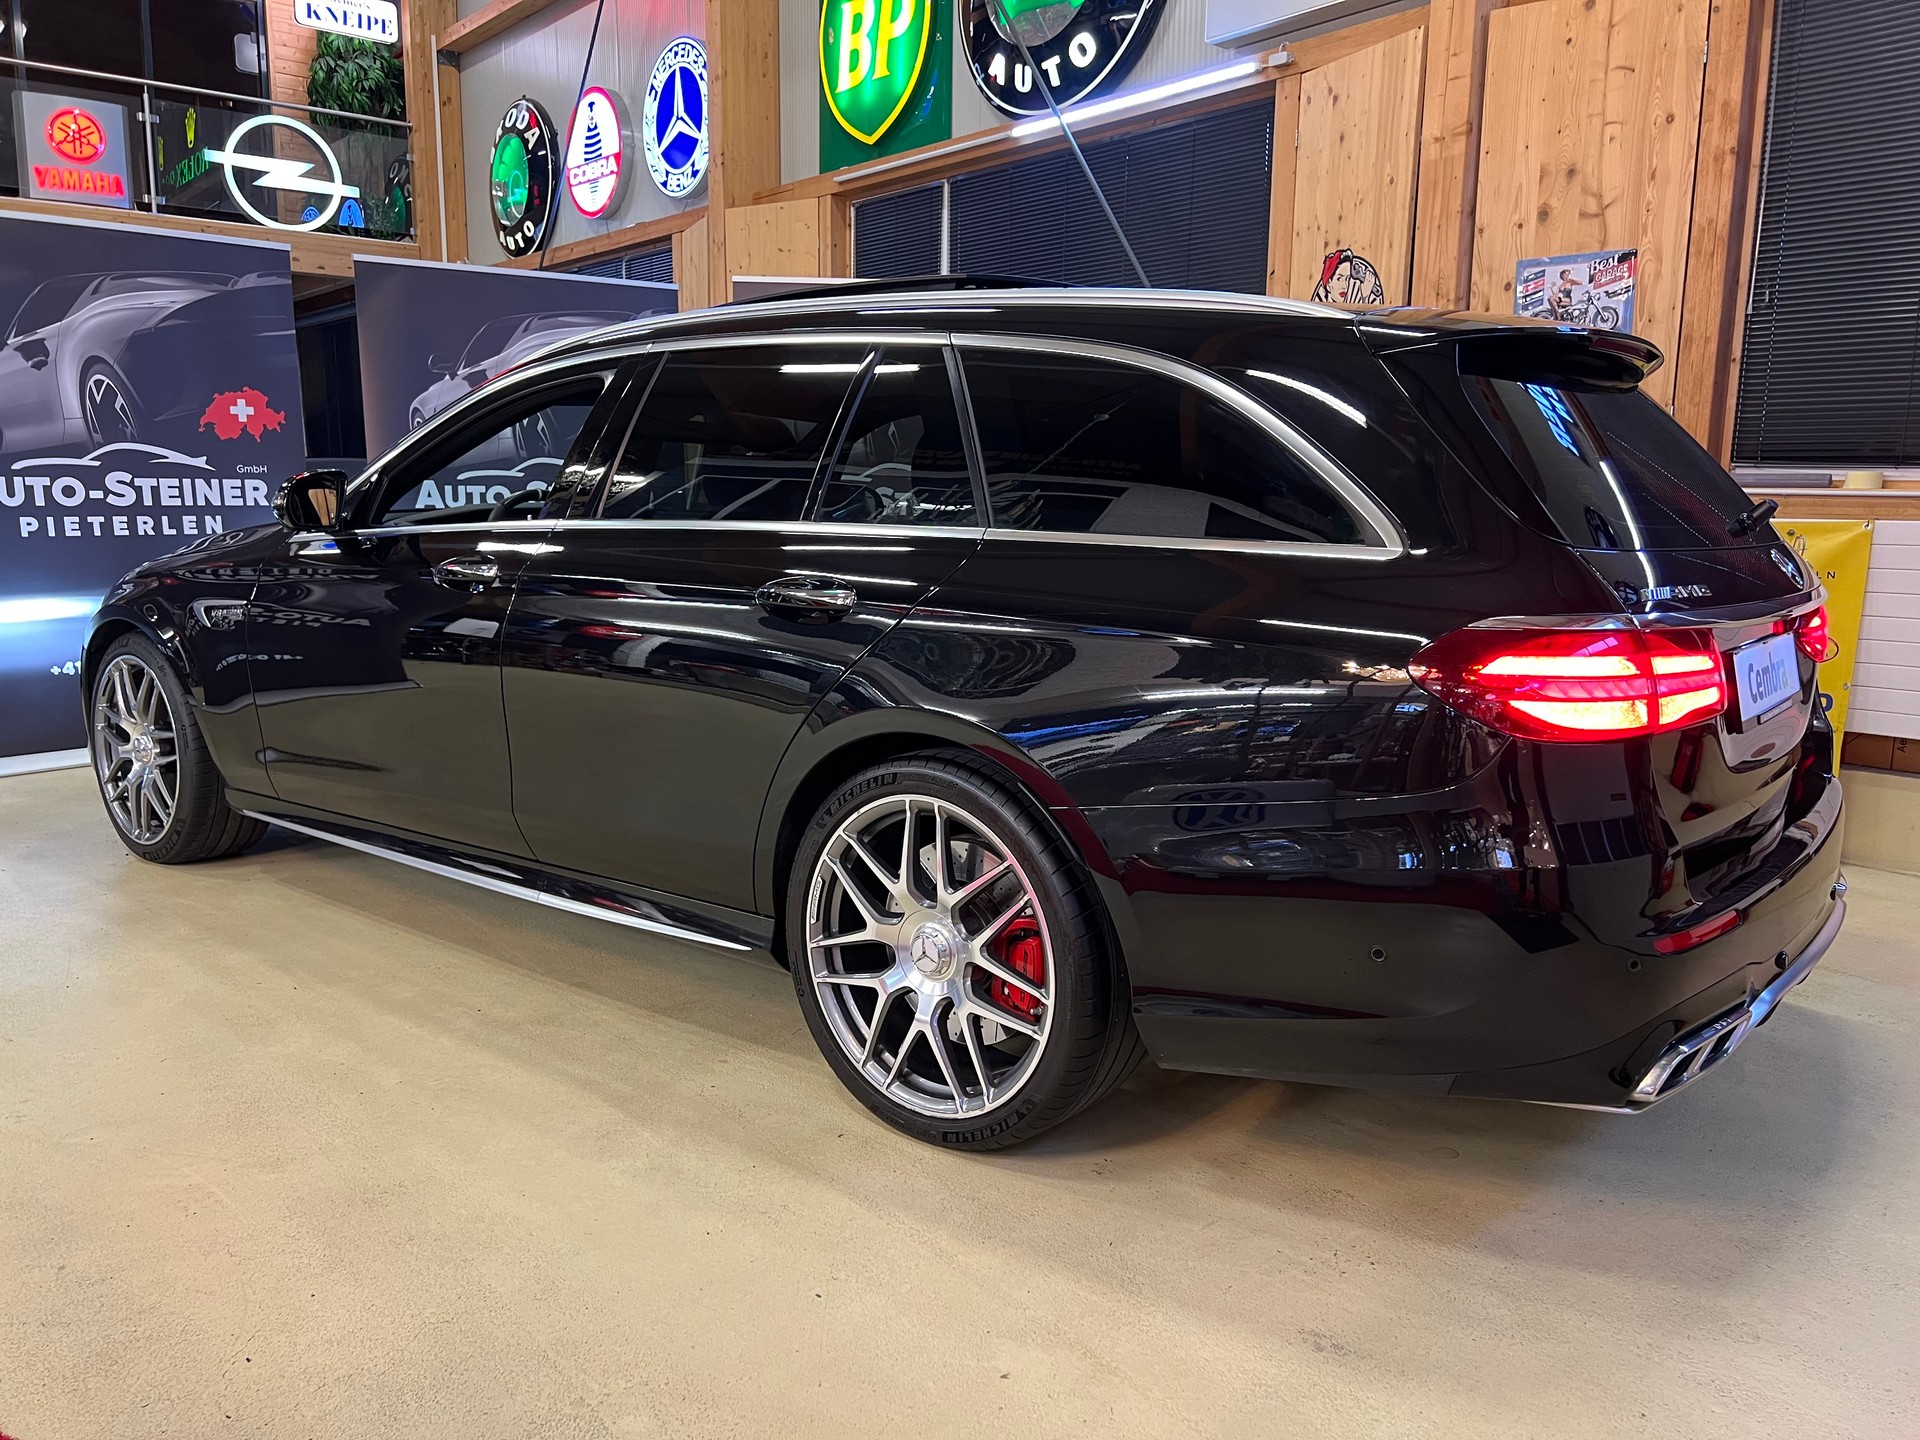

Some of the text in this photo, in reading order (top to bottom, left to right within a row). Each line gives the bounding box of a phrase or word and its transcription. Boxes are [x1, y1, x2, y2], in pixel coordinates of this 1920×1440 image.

[306, 2, 393, 36] KNEIPE
[835, 0, 916, 93] BP
[988, 31, 1097, 93] AUTO
[652, 43, 706, 89] MERCEDES
[33, 165, 125, 197] YAMAHA
[569, 155, 619, 186] COBRA
[667, 165, 694, 191] BENZ
[500, 220, 535, 251] AUTO
[1587, 253, 1621, 274] Best
[1595, 263, 1629, 282] GARAGE
[236, 464, 268, 474] GmbH
[0, 471, 269, 507] UTO-STEINER
[19, 515, 223, 538] PIETERLEN
[1748, 651, 1789, 704] Cembra
[829, 773, 894, 815] MICHELIN
[951, 1114, 1020, 1143] MICHELIN
